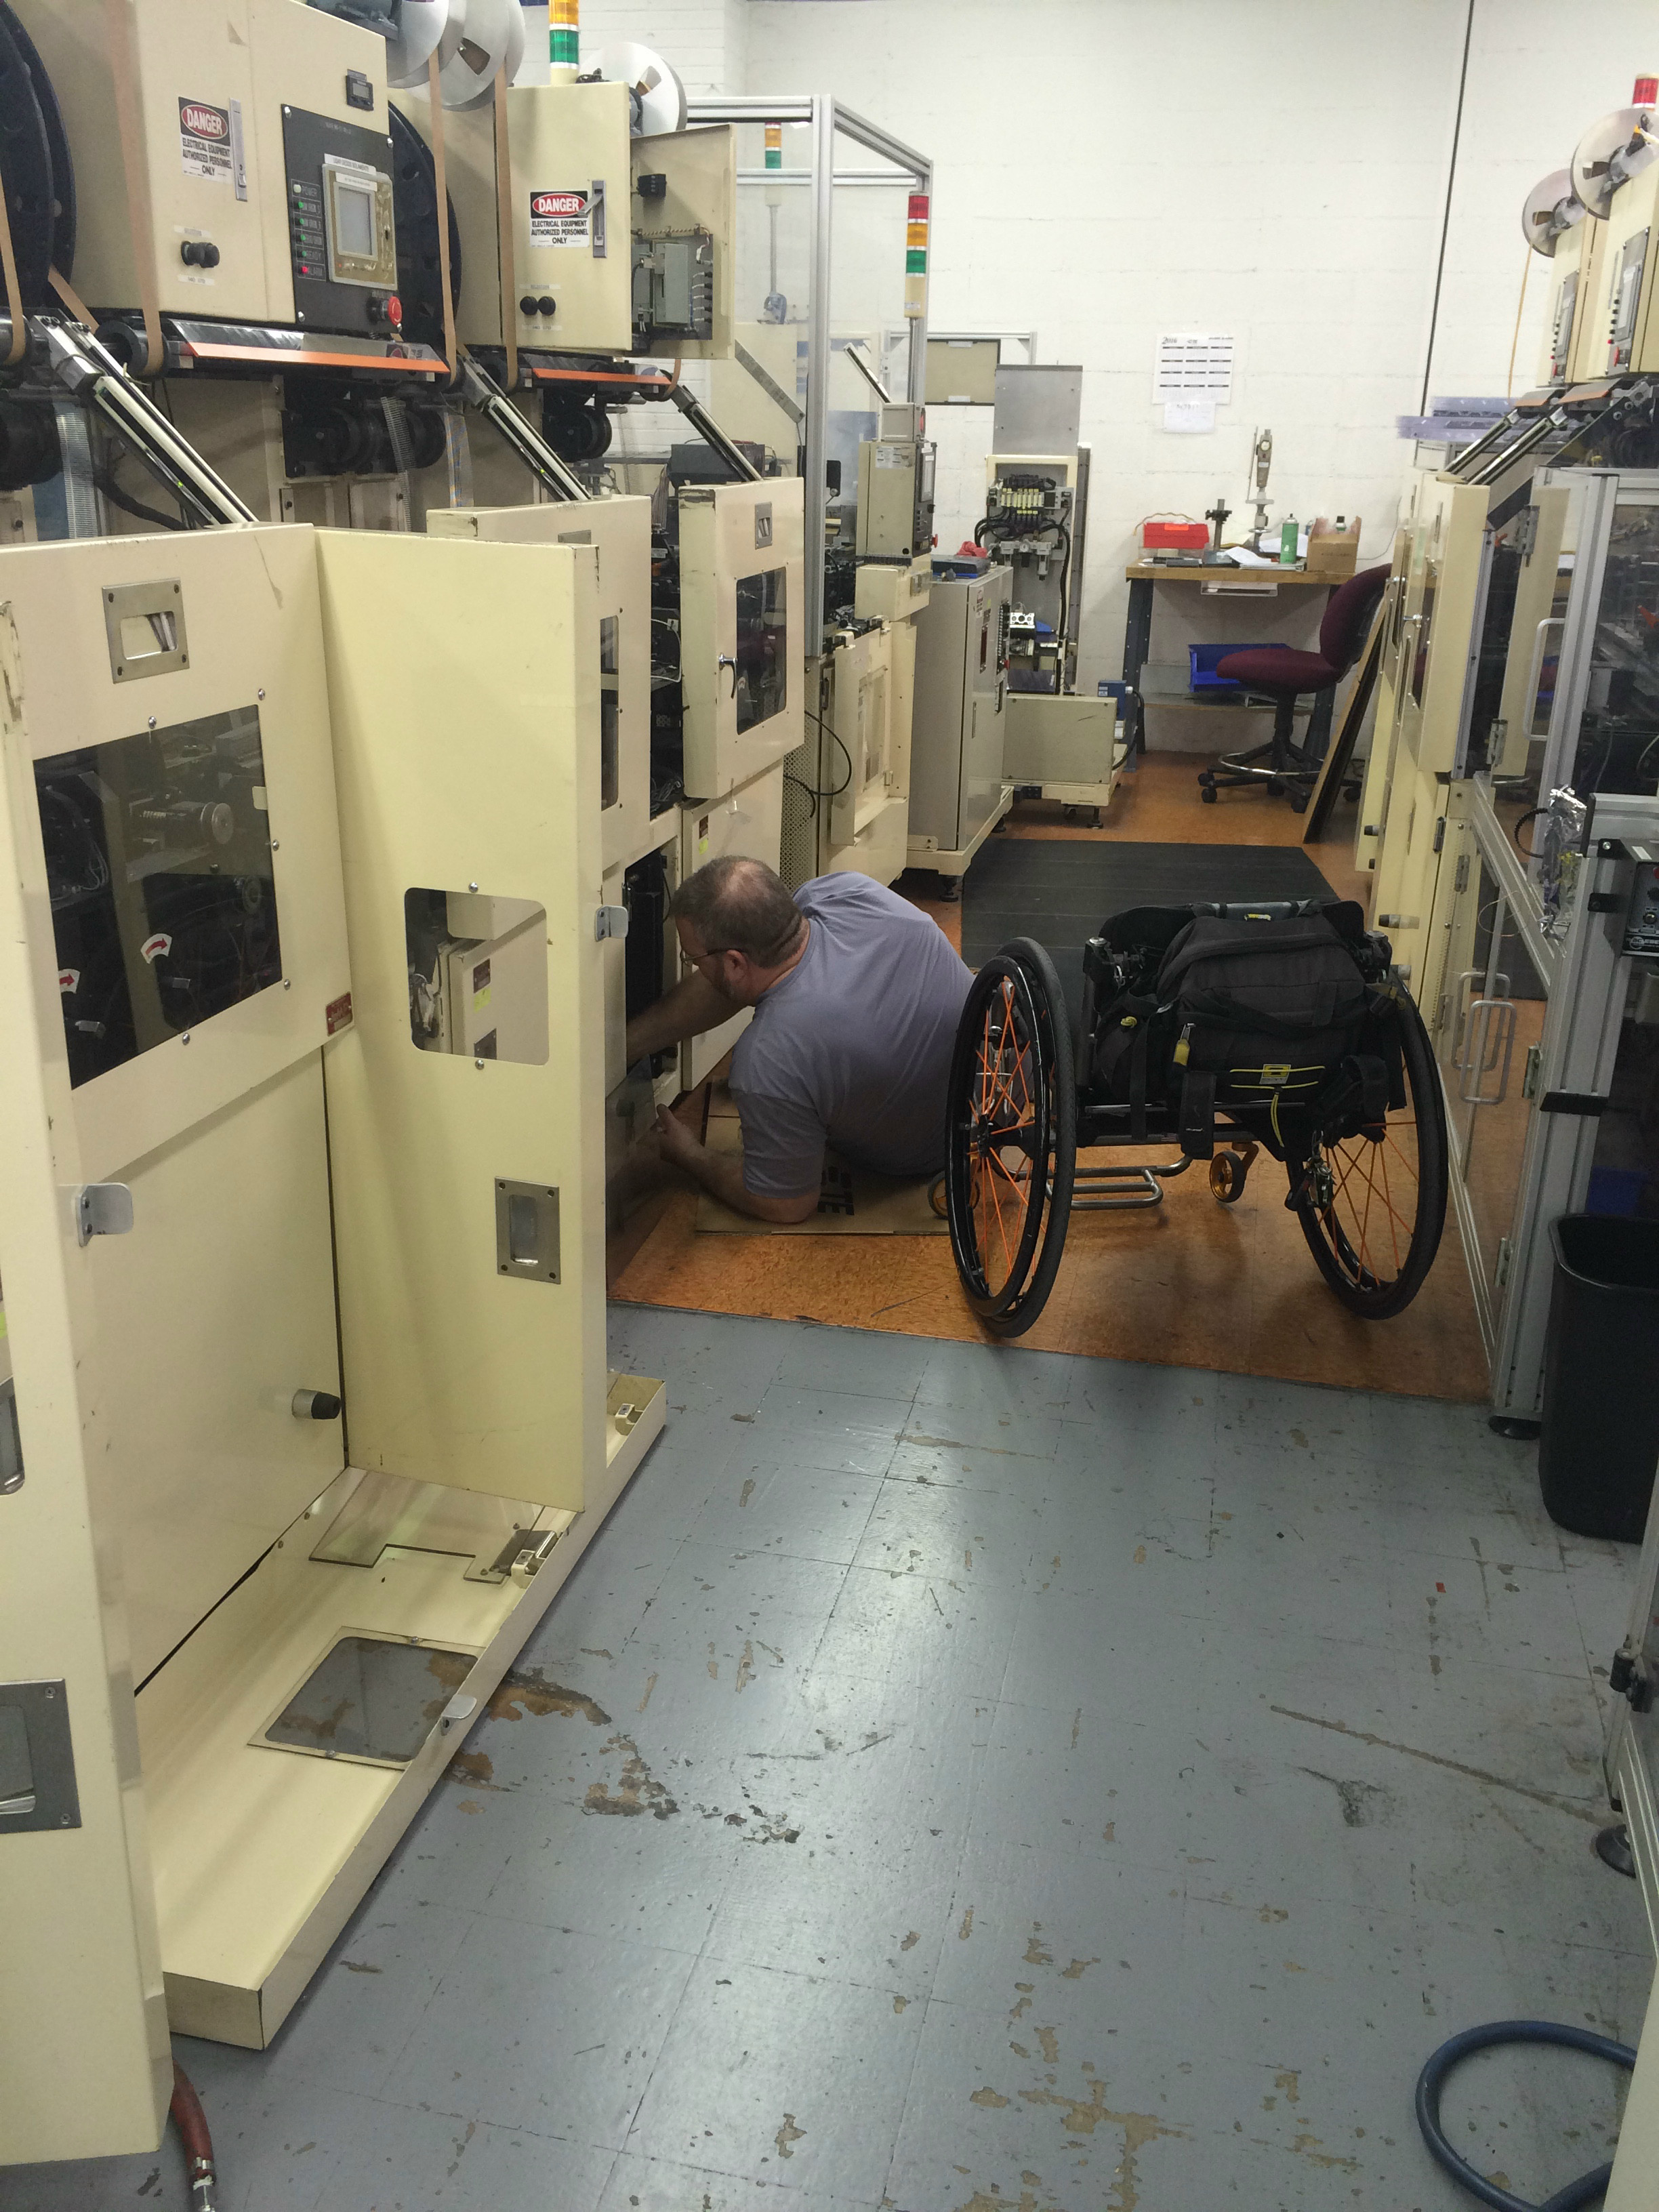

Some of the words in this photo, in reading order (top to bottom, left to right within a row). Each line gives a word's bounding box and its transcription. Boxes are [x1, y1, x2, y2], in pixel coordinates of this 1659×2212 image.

[186, 108, 223, 136] DANGER
[182, 138, 207, 152] ELECTRICAL
[202, 165, 215, 176] ONLY
[538, 198, 579, 212] DANGER
